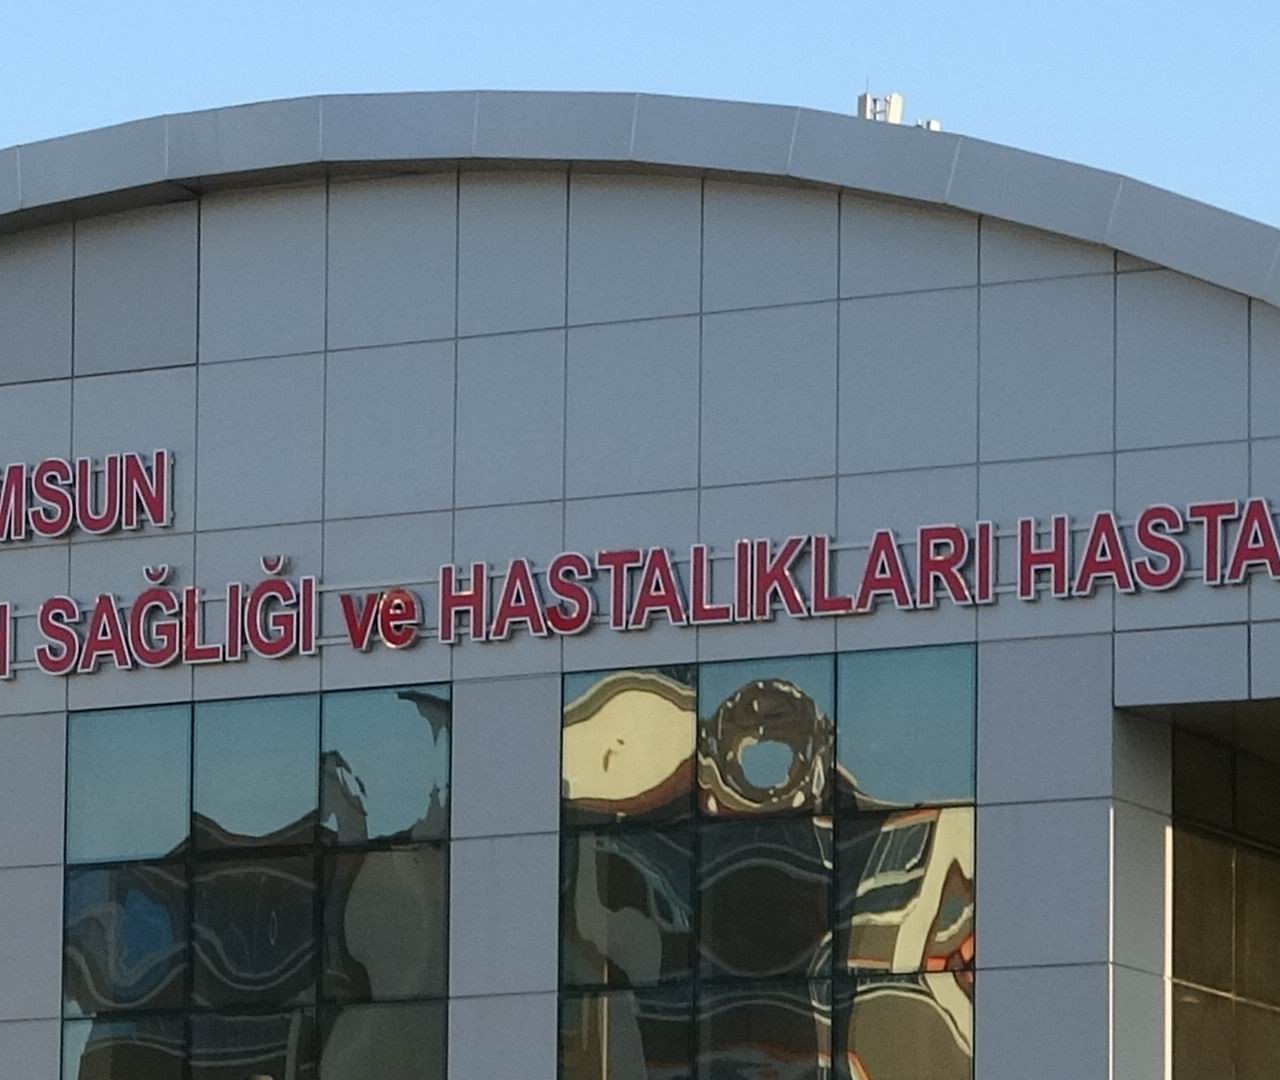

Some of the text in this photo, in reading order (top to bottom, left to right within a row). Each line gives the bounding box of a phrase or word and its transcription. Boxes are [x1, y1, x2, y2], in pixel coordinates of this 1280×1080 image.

[34, 554, 317, 676] SAĞLIĞI
[339, 586, 421, 649] ve
[438, 520, 994, 643] HASTALIKLARI
